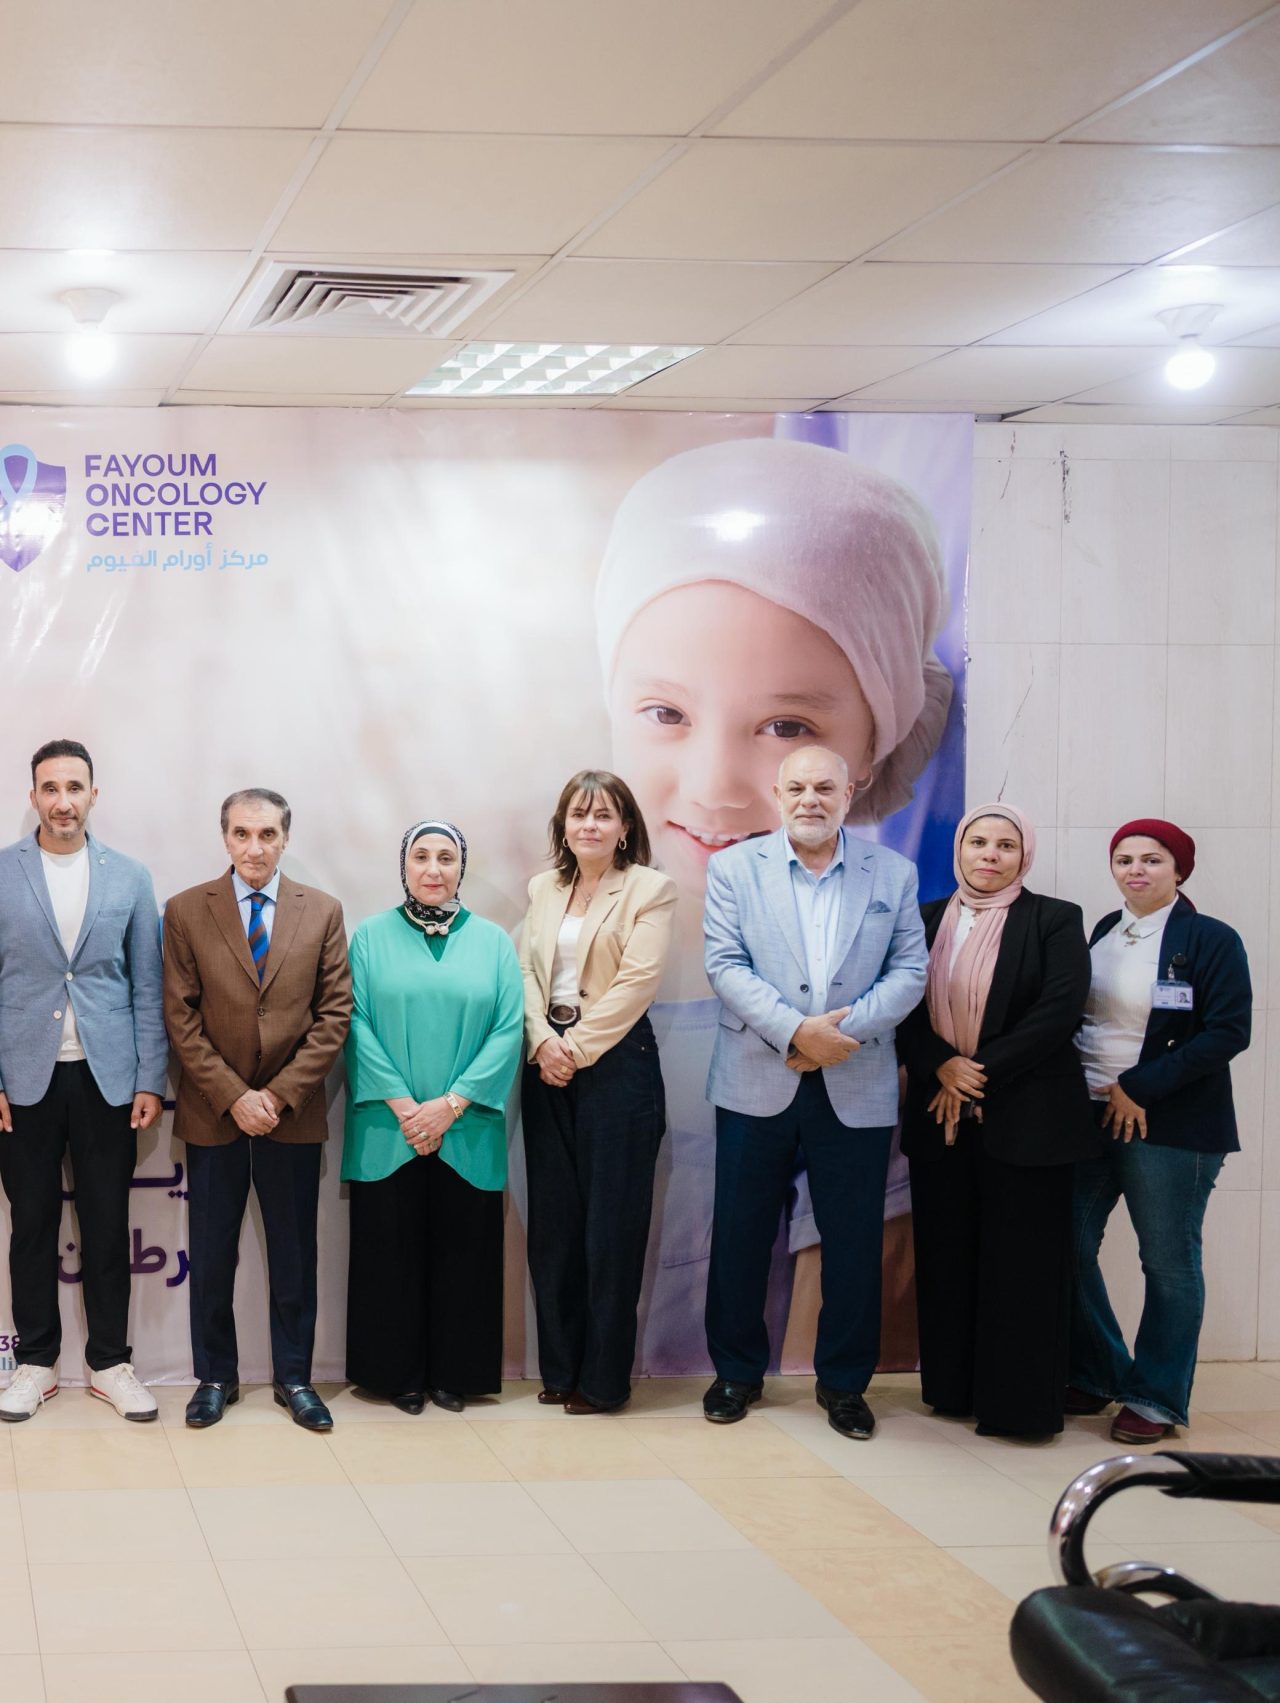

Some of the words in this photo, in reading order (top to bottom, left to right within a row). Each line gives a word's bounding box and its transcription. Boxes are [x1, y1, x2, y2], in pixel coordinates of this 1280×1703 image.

[84, 454, 216, 477] FAYOUM
[86, 482, 267, 506] ONCOLOGY
[86, 512, 213, 537] CENTER
[162, 542, 212, 571] أورام
[219, 549, 269, 570] مركز
